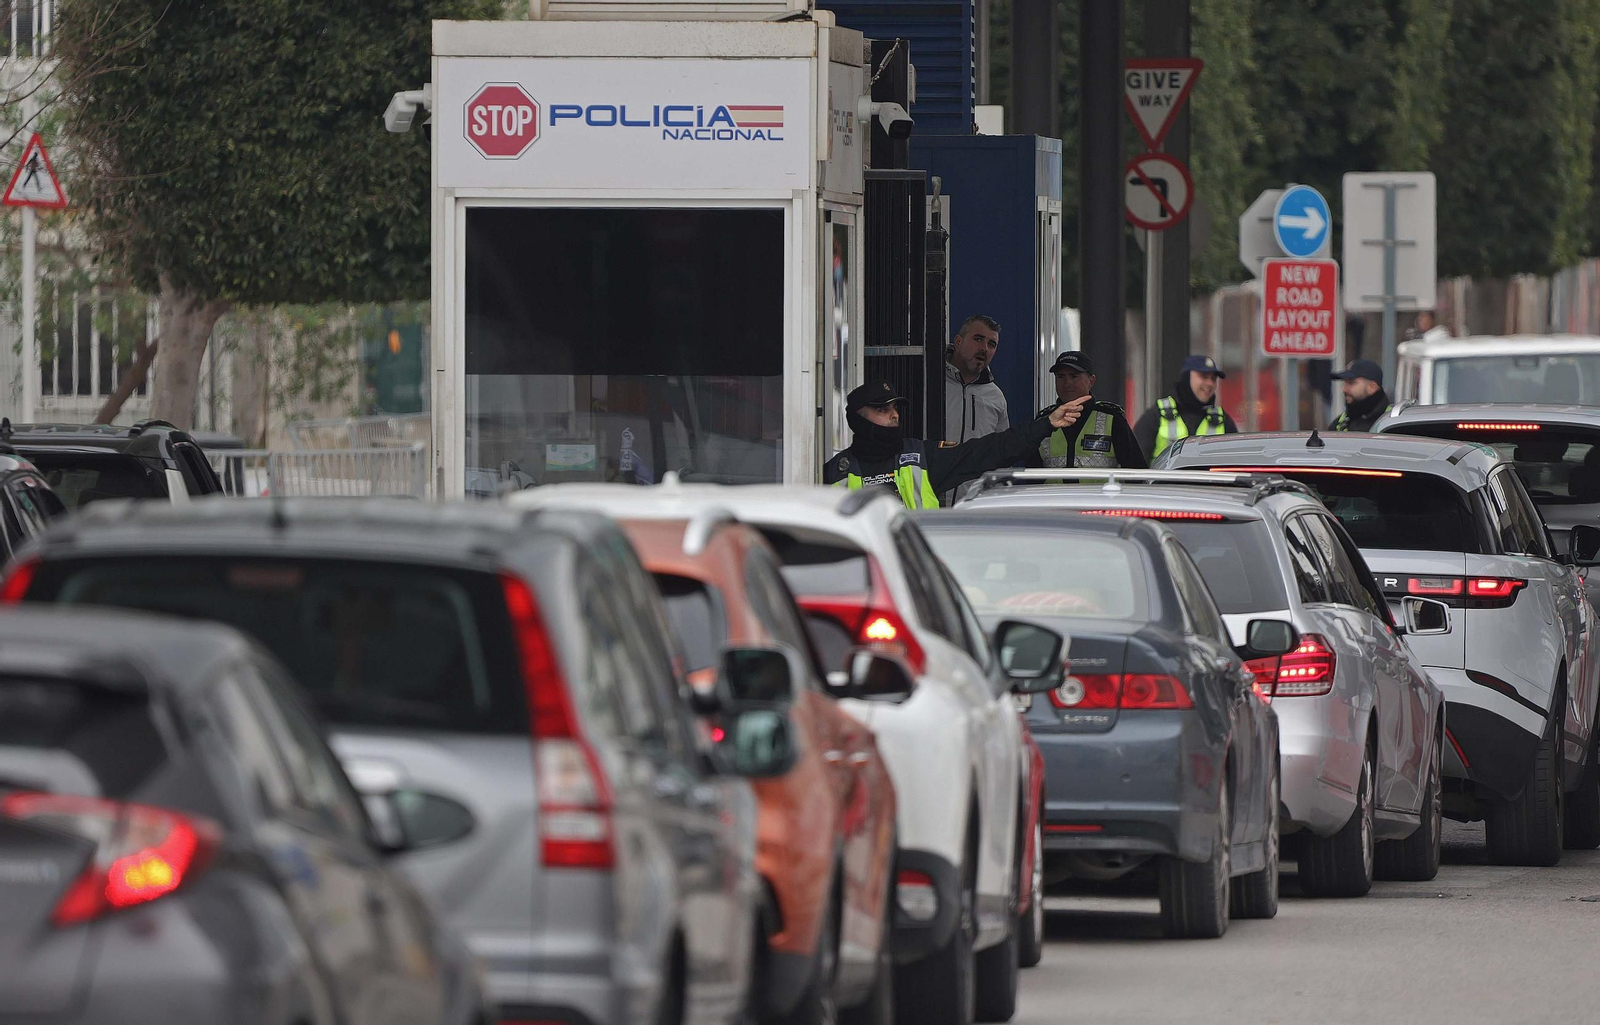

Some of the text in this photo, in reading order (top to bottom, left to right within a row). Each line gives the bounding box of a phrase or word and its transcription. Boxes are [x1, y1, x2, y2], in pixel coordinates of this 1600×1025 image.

[1126, 71, 1181, 89] GIVE
[1138, 94, 1173, 107] WAY
[471, 105, 533, 137] STOP
[662, 128, 784, 141] NACIONAL
[1280, 266, 1320, 283] NEW
[1277, 288, 1324, 306] ROAD
[1267, 309, 1331, 327] LAYOUT
[1270, 332, 1327, 350] AHEAD
[862, 473, 891, 482] OLICIA
